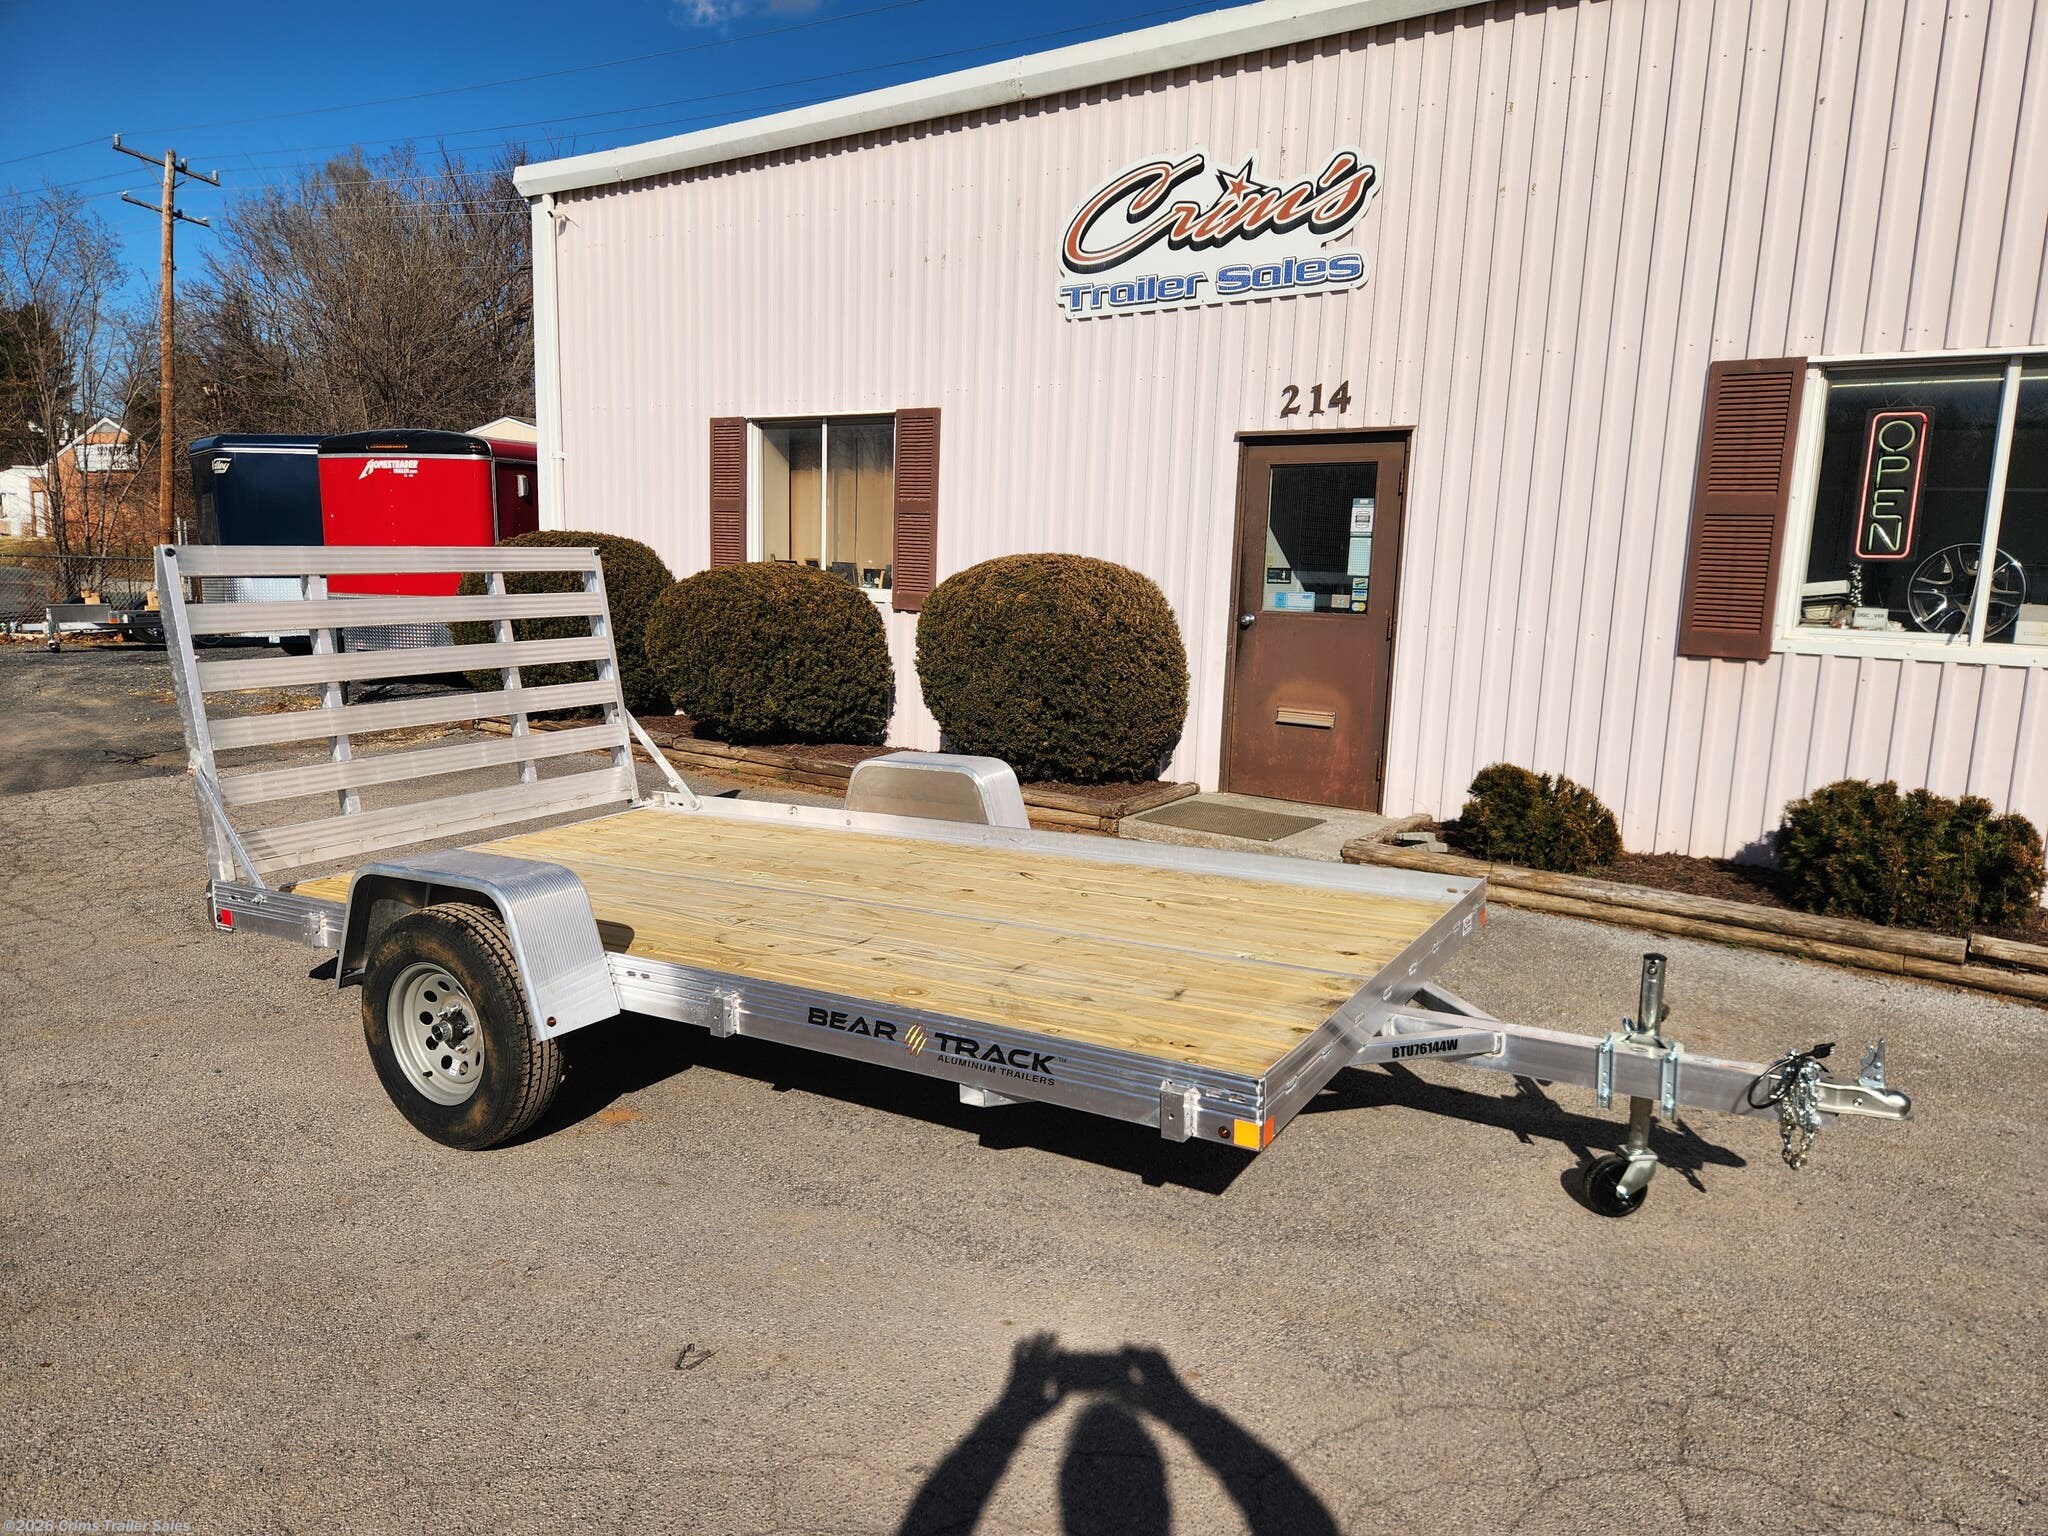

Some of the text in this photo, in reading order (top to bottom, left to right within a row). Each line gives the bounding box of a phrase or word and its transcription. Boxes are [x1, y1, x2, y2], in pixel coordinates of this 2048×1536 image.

[1062, 152, 1376, 274] Crim's
[1061, 254, 1363, 310] Trailer Sales
[1280, 380, 1352, 418] 214
[1868, 420, 1916, 551] OPEN
[808, 1007, 897, 1041] BEAR
[935, 1032, 1056, 1074] TRACK
[1392, 1039, 1458, 1058] BTU76144W
[937, 1054, 1055, 1086] ALUMINUM TRAILERS
